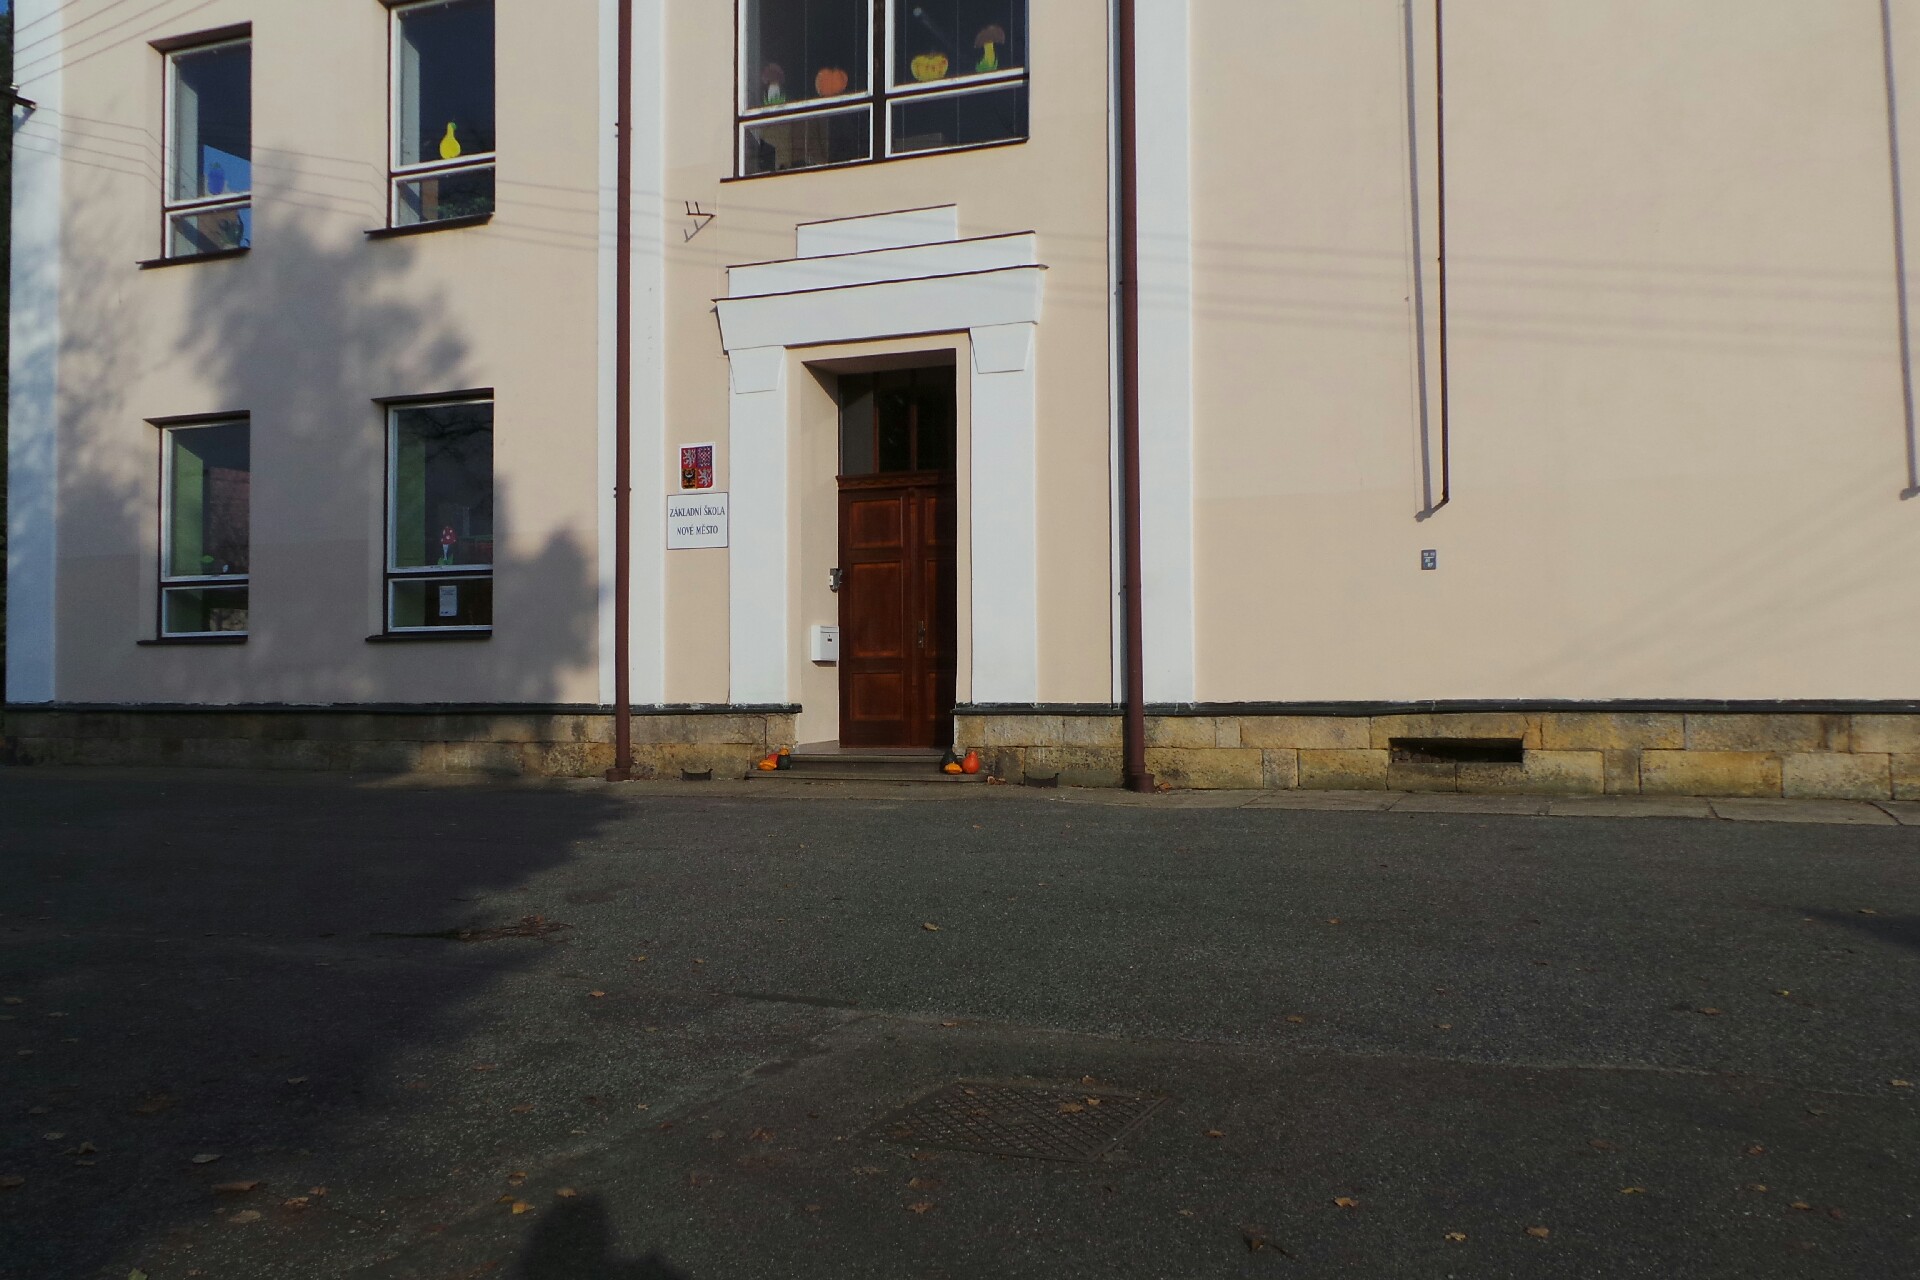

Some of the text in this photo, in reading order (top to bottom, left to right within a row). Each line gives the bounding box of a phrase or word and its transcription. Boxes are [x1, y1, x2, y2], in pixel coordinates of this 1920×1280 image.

[669, 505, 725, 517] ZÁKLADNÍ ŠKOLA
[676, 523, 718, 535] NOVÉ MĚSTO
